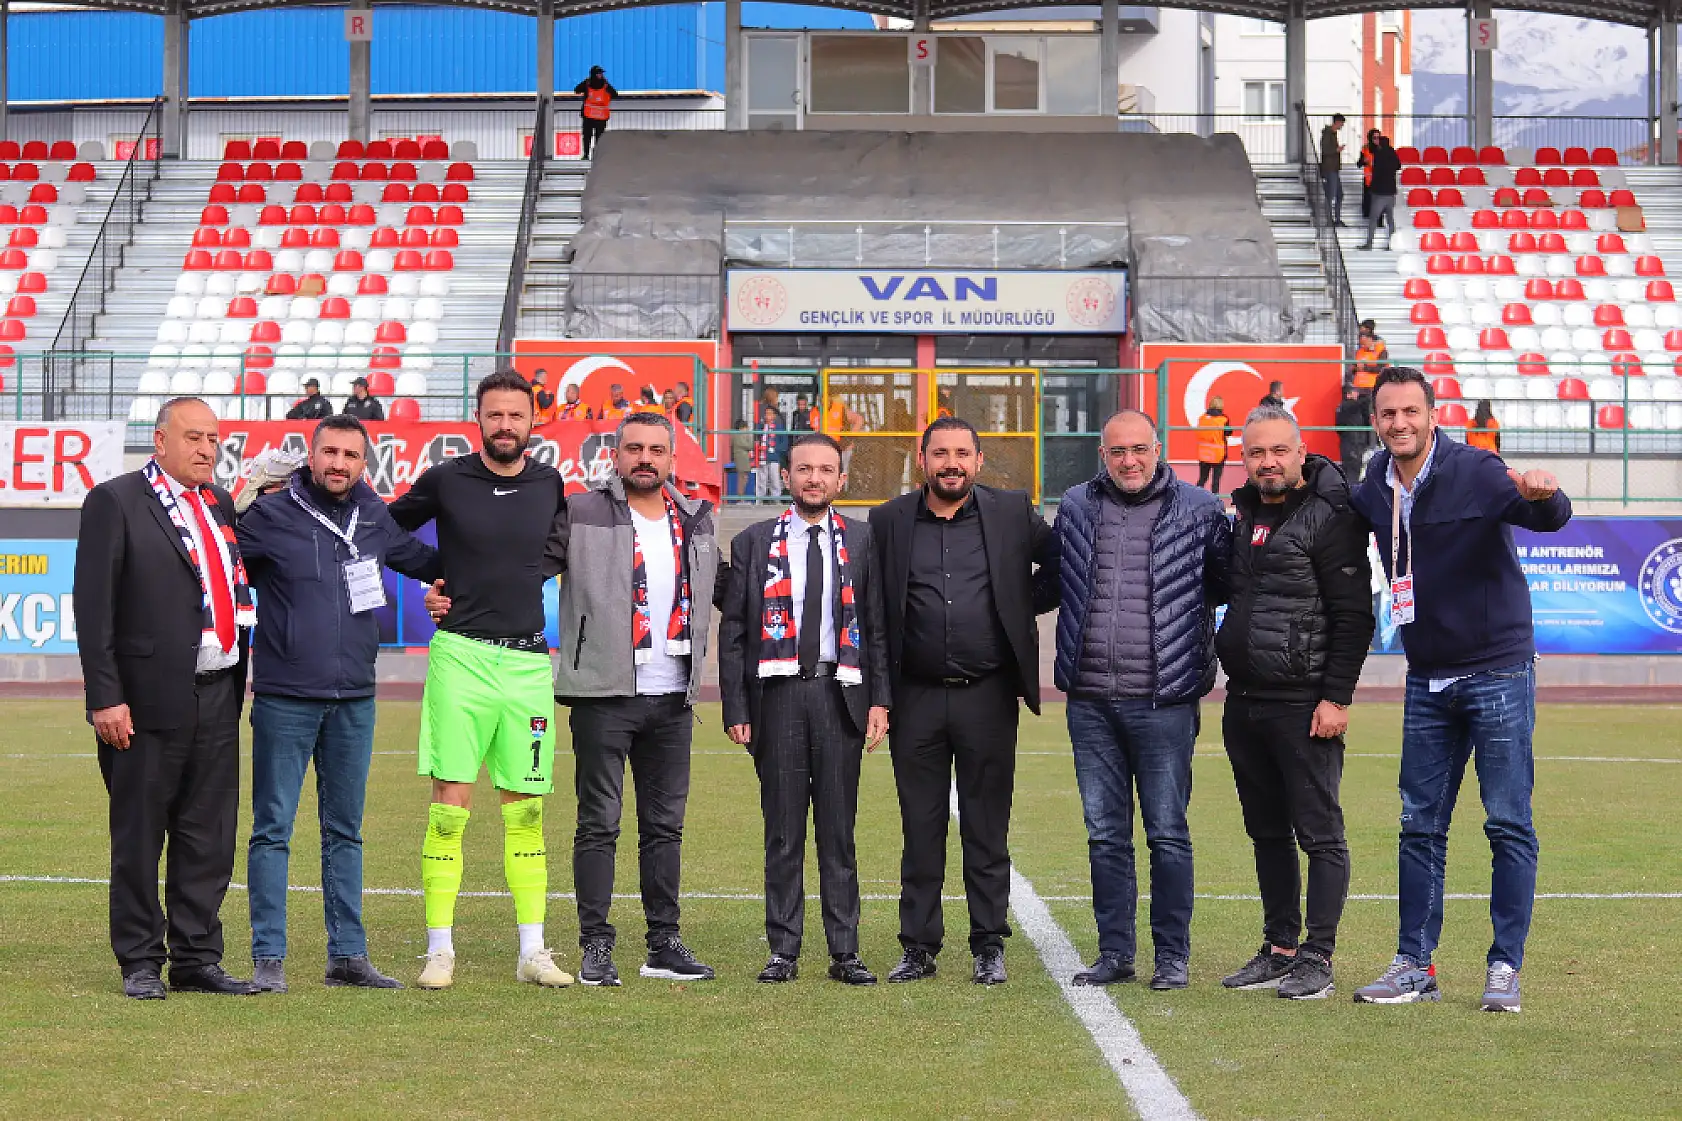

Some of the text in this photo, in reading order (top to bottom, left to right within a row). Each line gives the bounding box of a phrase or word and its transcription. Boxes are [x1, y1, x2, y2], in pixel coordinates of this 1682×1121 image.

[351, 16, 365, 35] R
[858, 275, 998, 301] VAN
[799, 307, 1056, 328] GENÇLİK VE SPOR İL MÜDÜRLÜĞÜ
[0, 427, 95, 492] ER
[1530, 544, 1604, 558] ANTRENÖR
[531, 740, 542, 772] 1
